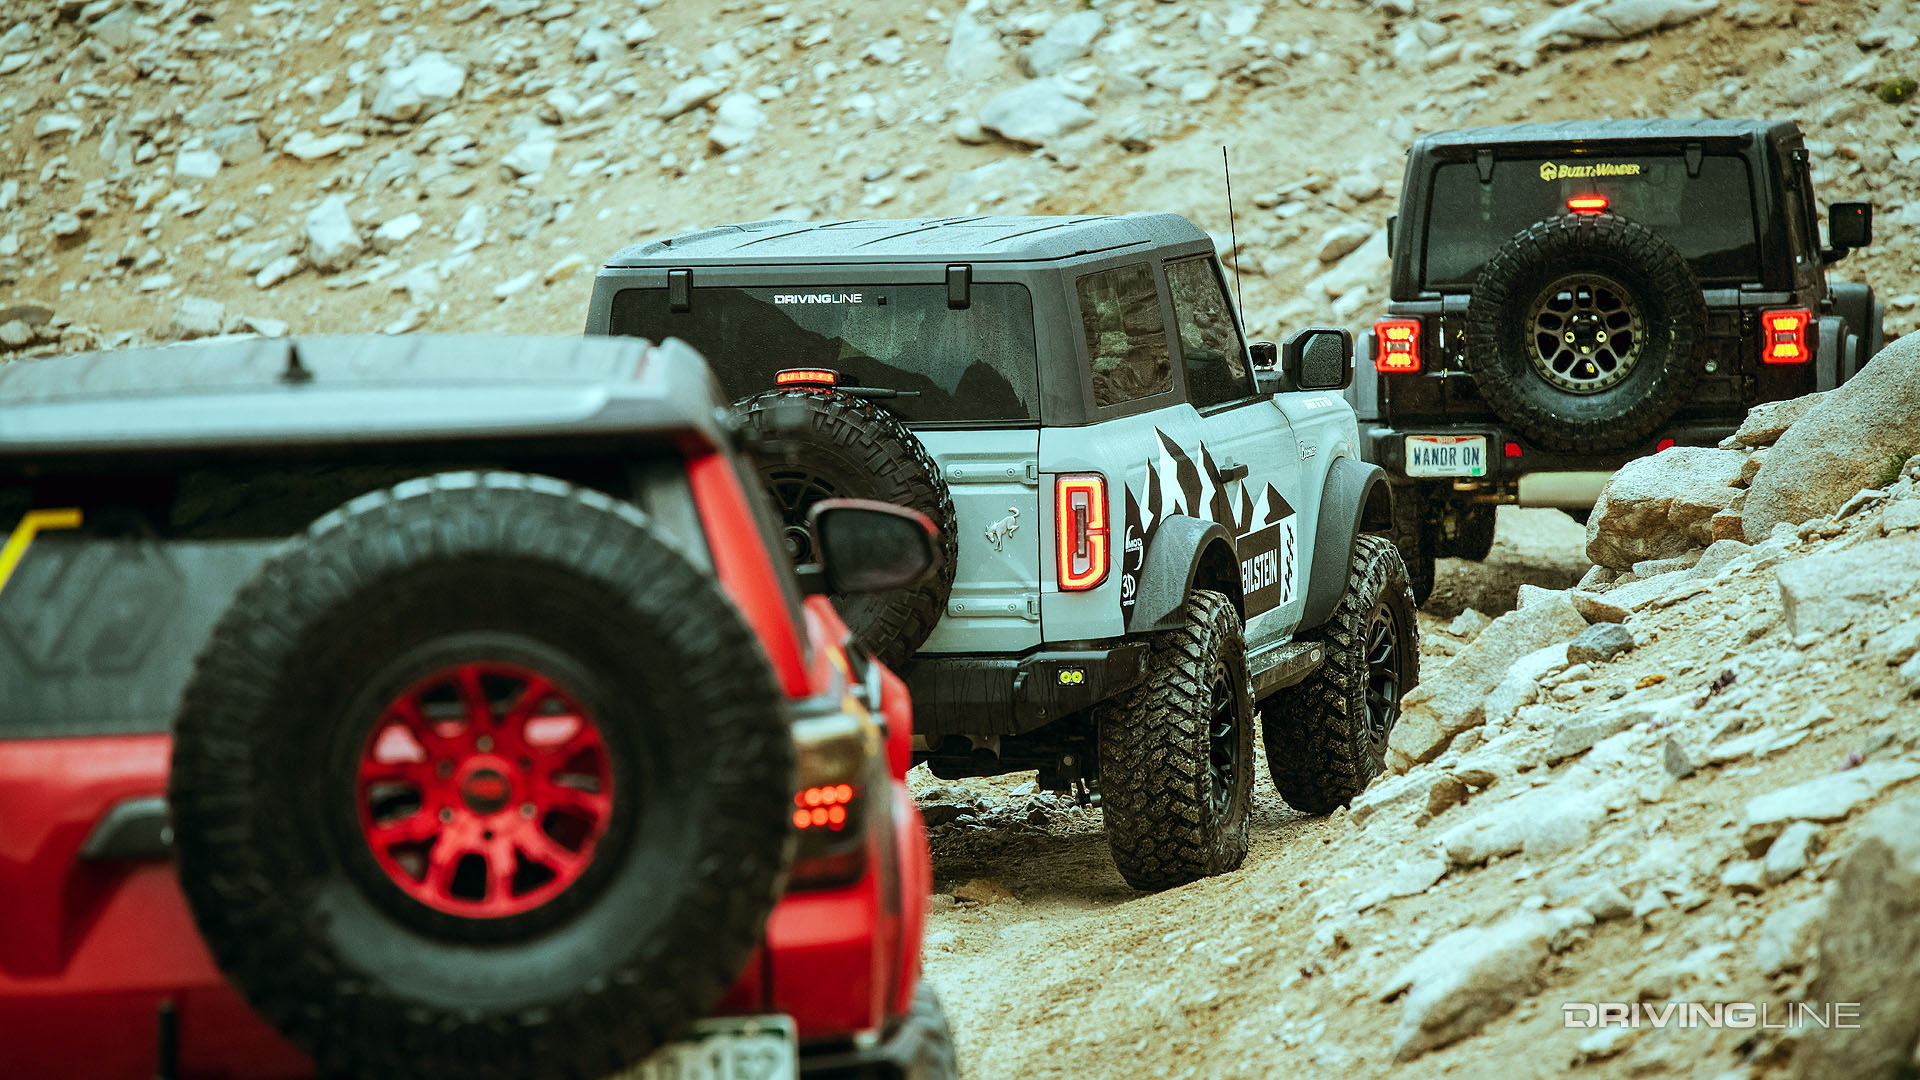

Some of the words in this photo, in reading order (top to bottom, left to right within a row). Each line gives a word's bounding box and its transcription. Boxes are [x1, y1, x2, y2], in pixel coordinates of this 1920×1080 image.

[774, 293, 863, 304] DRIVINGLINE
[1463, 447, 1480, 466] ON
[1241, 548, 1278, 595] BILSTEIN
